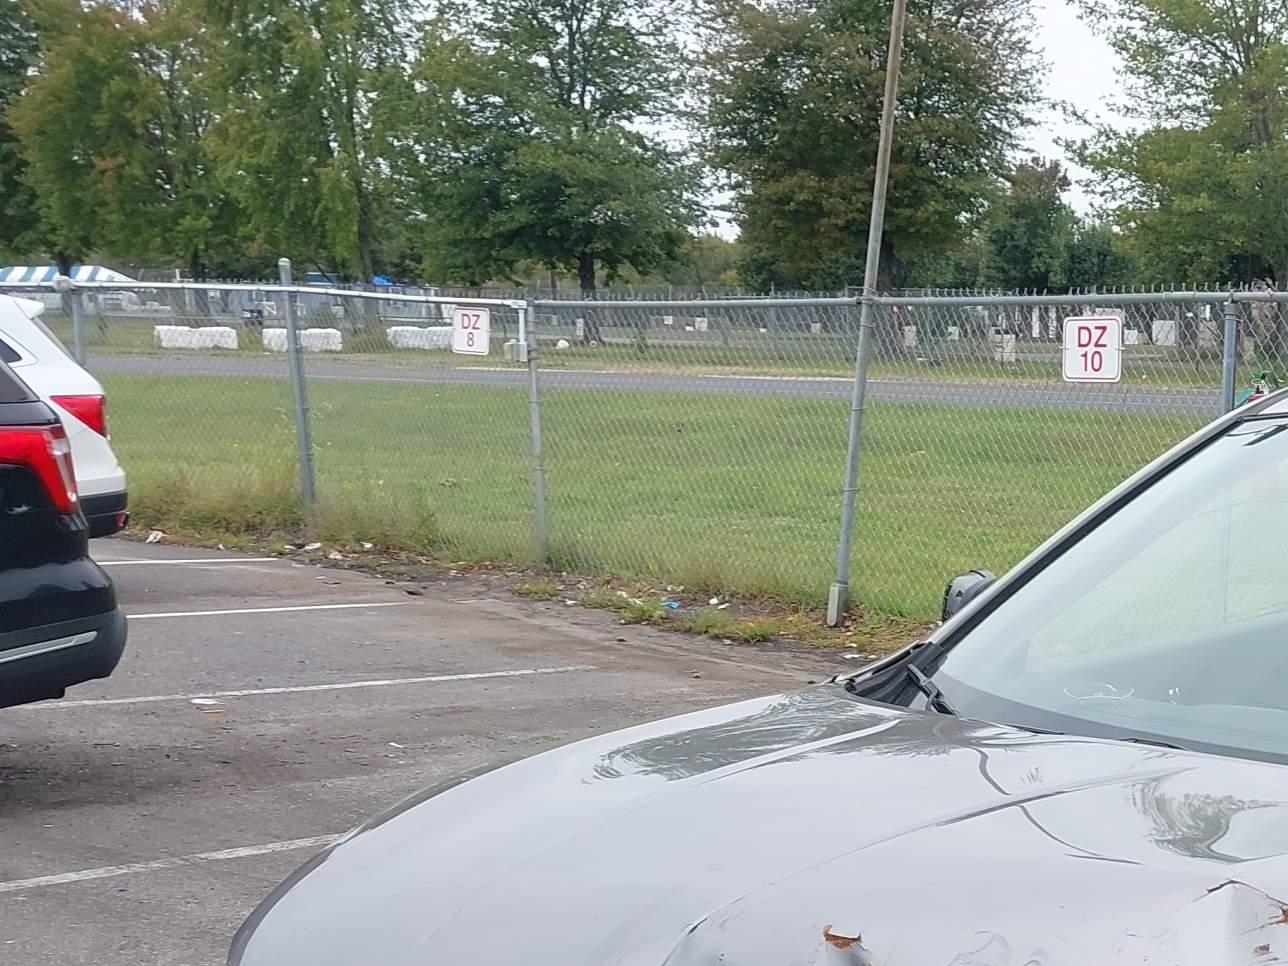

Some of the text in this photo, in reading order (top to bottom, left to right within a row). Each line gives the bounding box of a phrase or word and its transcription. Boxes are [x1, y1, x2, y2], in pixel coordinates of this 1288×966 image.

[461, 313, 480, 330] DZ
[467, 331, 475, 347] 8
[1077, 325, 1108, 348] DZ
[1080, 350, 1103, 372] 10
